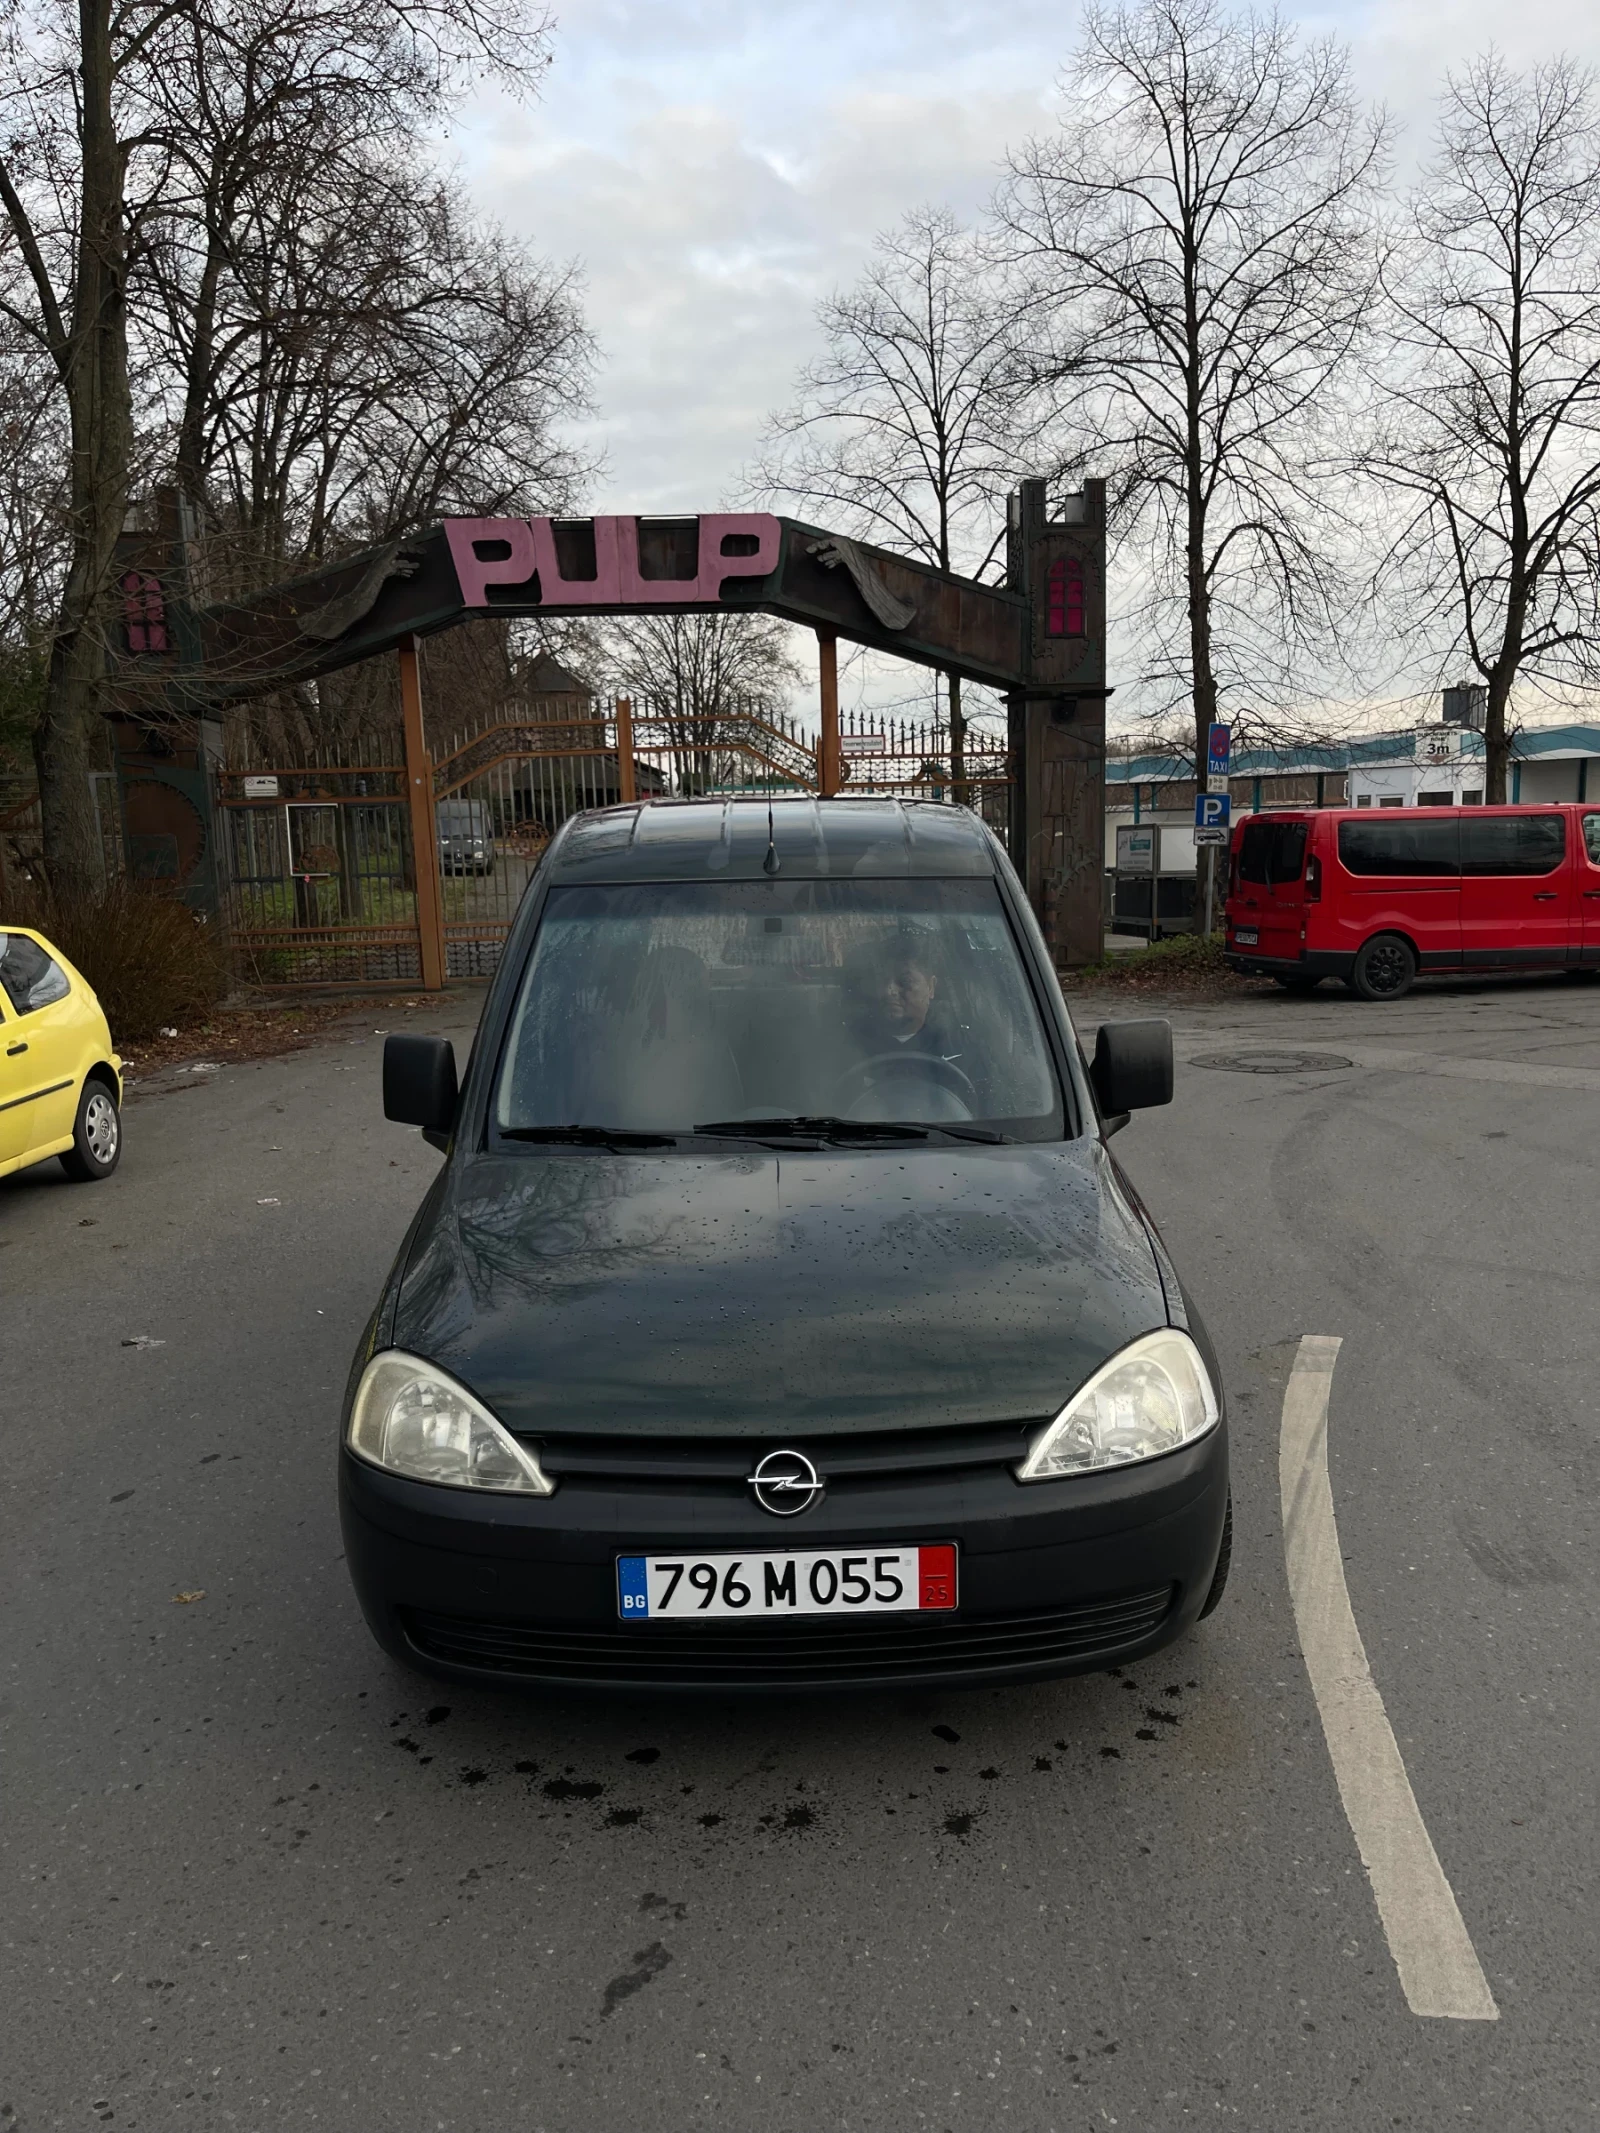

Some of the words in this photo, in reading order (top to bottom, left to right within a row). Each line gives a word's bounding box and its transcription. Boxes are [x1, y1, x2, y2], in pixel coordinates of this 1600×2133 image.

[444, 513, 781, 607] PULP
[1427, 743, 1449, 754] 3m
[1210, 761, 1227, 773] TAXI
[1203, 799, 1222, 825] P
[655, 1562, 751, 1609] 796
[764, 1560, 796, 1607] M
[809, 1556, 903, 1605] 055
[624, 1595, 645, 1609] BG
[926, 1585, 948, 1602] 25
